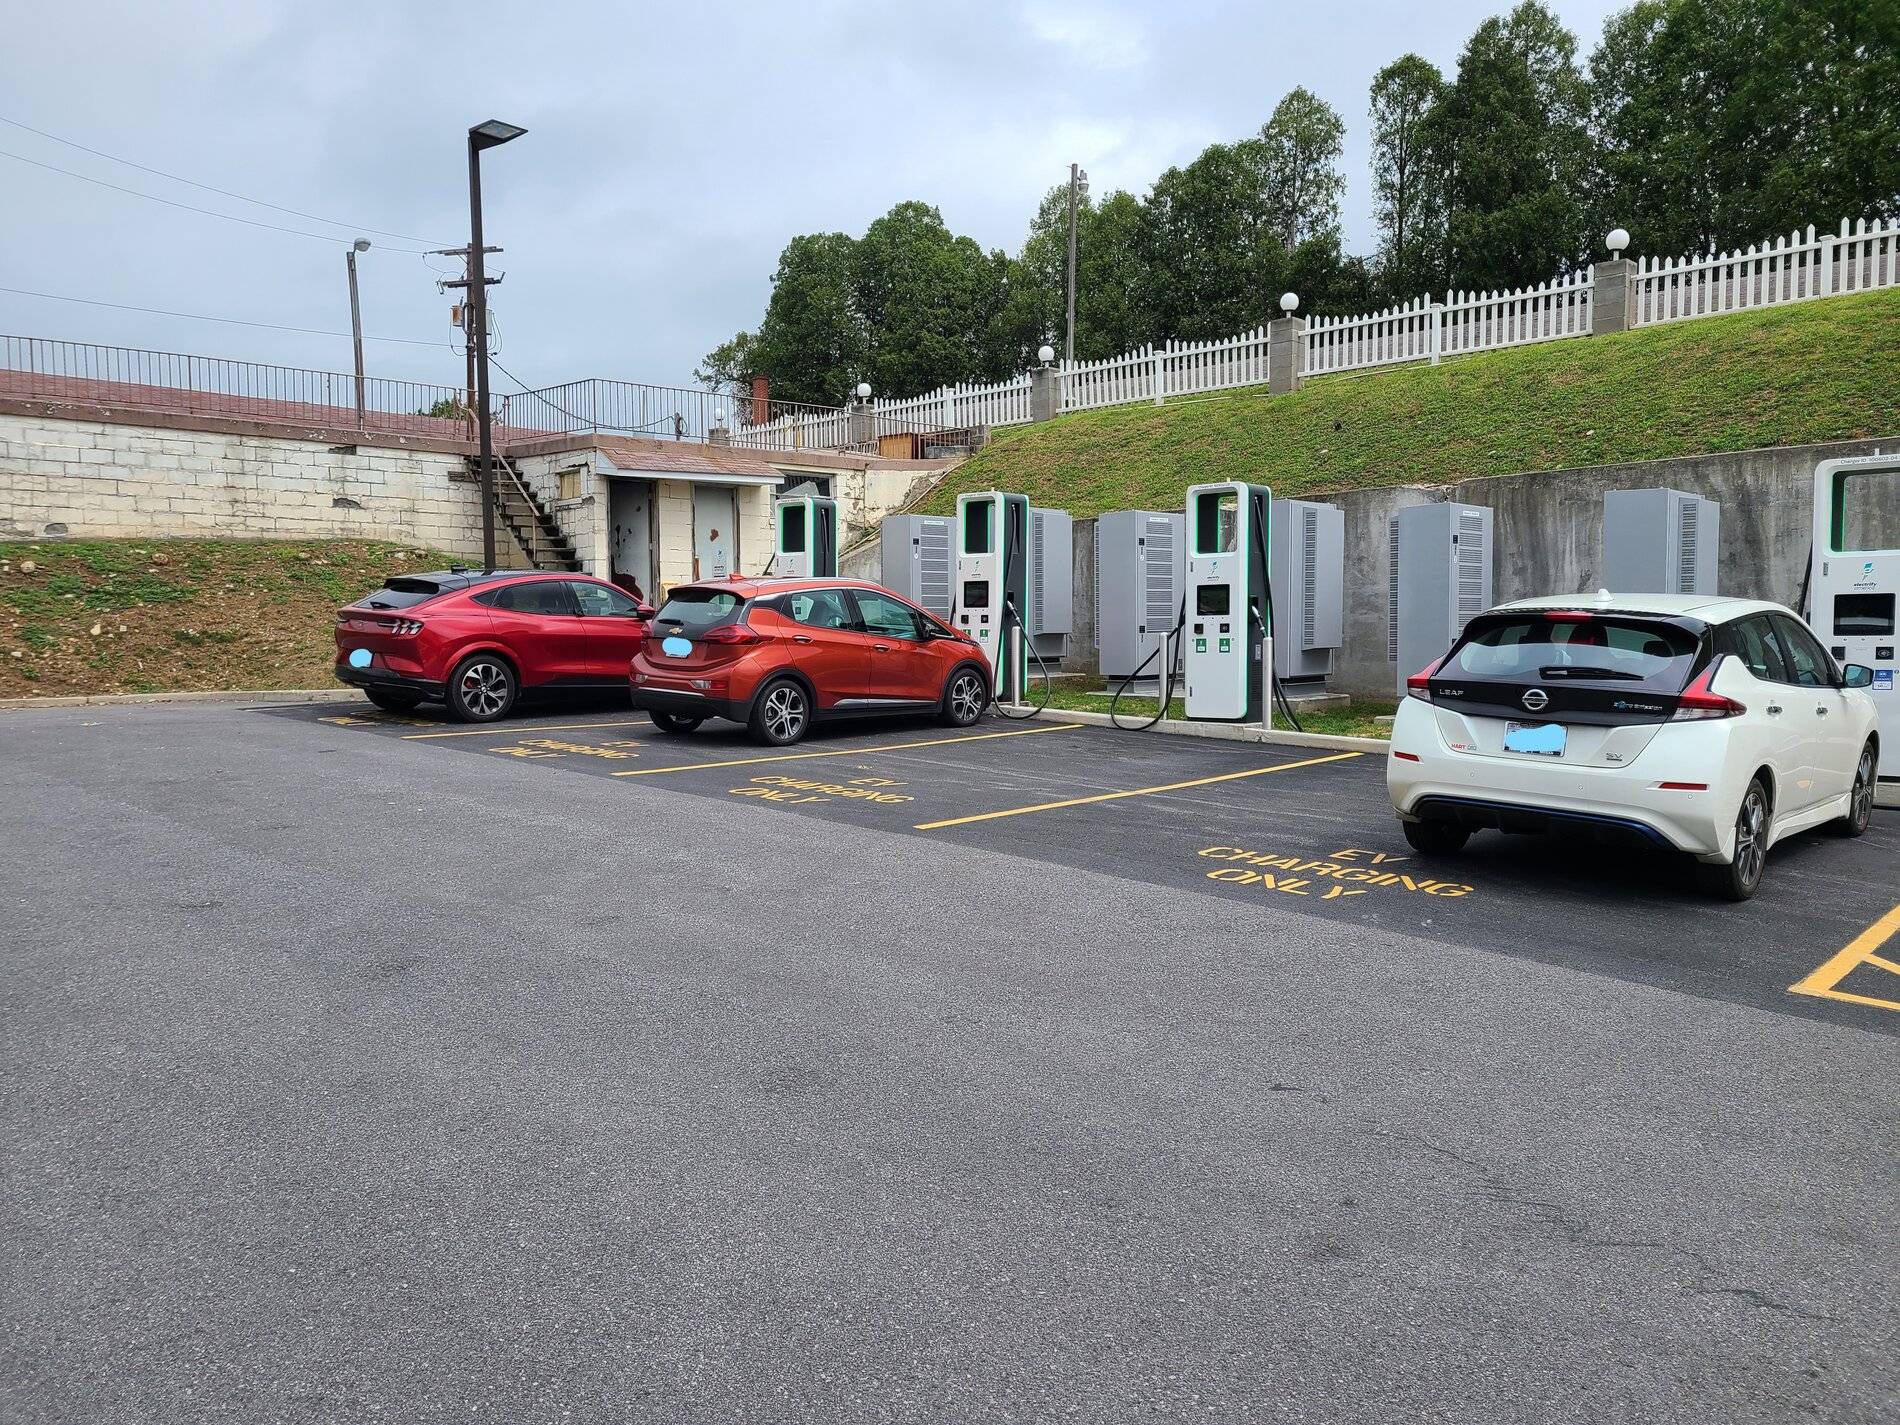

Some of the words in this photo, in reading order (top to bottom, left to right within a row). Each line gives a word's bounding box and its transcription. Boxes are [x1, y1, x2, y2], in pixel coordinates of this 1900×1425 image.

[1439, 688, 1465, 696] LEAF
[750, 776, 915, 803] CHARGING
[848, 777, 910, 787] EV
[728, 787, 832, 804] ONLY
[1329, 848, 1413, 864] EV
[1197, 846, 1475, 897] CHARGING
[1206, 868, 1368, 900] ONLY
